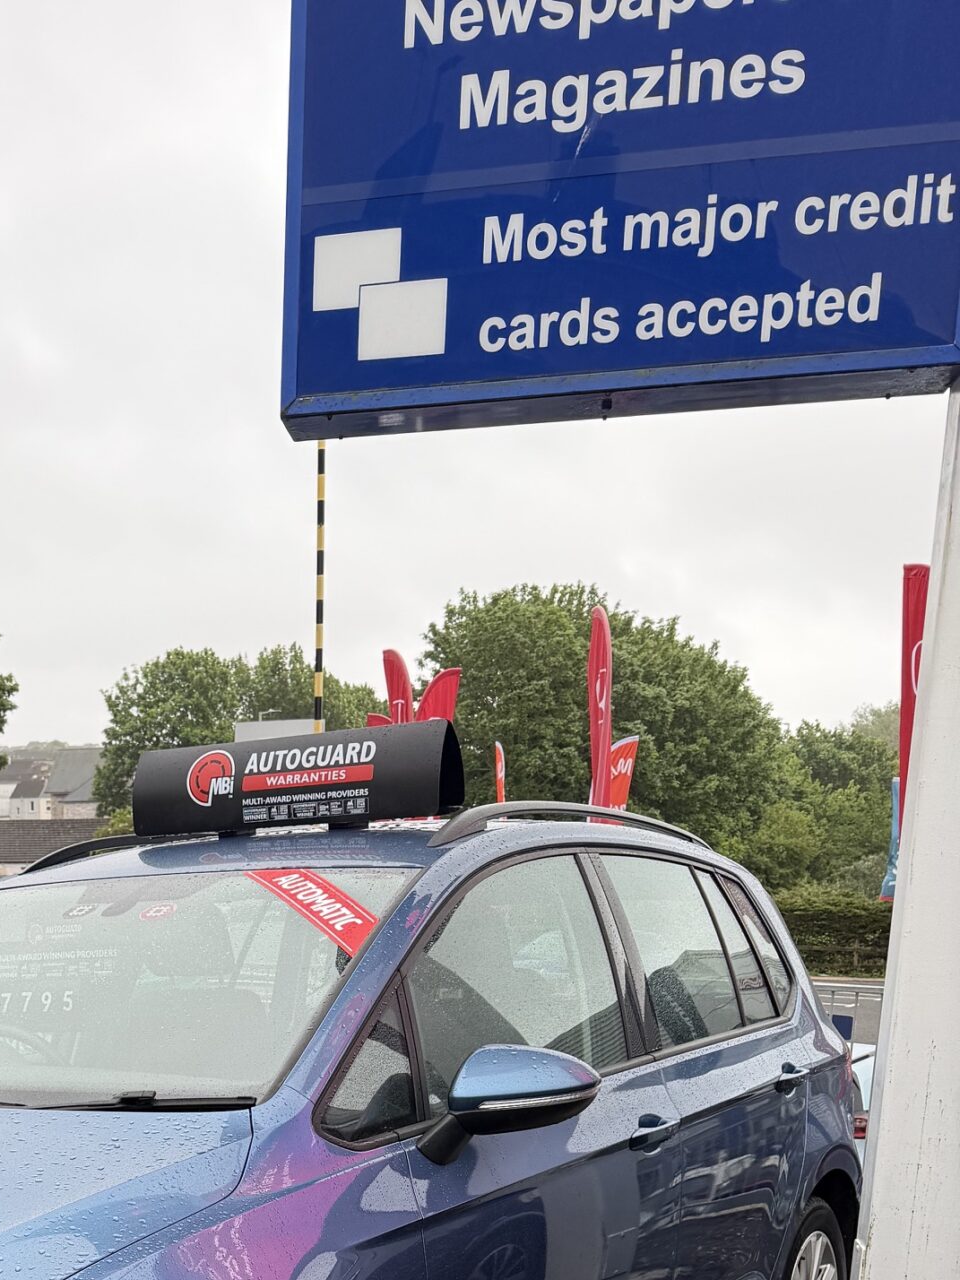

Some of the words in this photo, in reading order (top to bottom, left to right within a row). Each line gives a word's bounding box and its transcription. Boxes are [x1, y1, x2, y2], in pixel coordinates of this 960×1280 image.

[459, 48, 806, 134] Magazines
[482, 206, 608, 265] Most
[623, 194, 778, 258] major
[794, 172, 957, 237] credit
[478, 296, 620, 354] cards
[635, 271, 883, 344] accepted
[244, 741, 377, 775] AUTOGUARD
[265, 769, 347, 787] WARRANTIES
[242, 795, 292, 807] MULTI-AWARD
[292, 792, 326, 802] WINNING
[327, 788, 369, 800] PROVIDERS
[272, 873, 363, 931] AUTOMATIC
